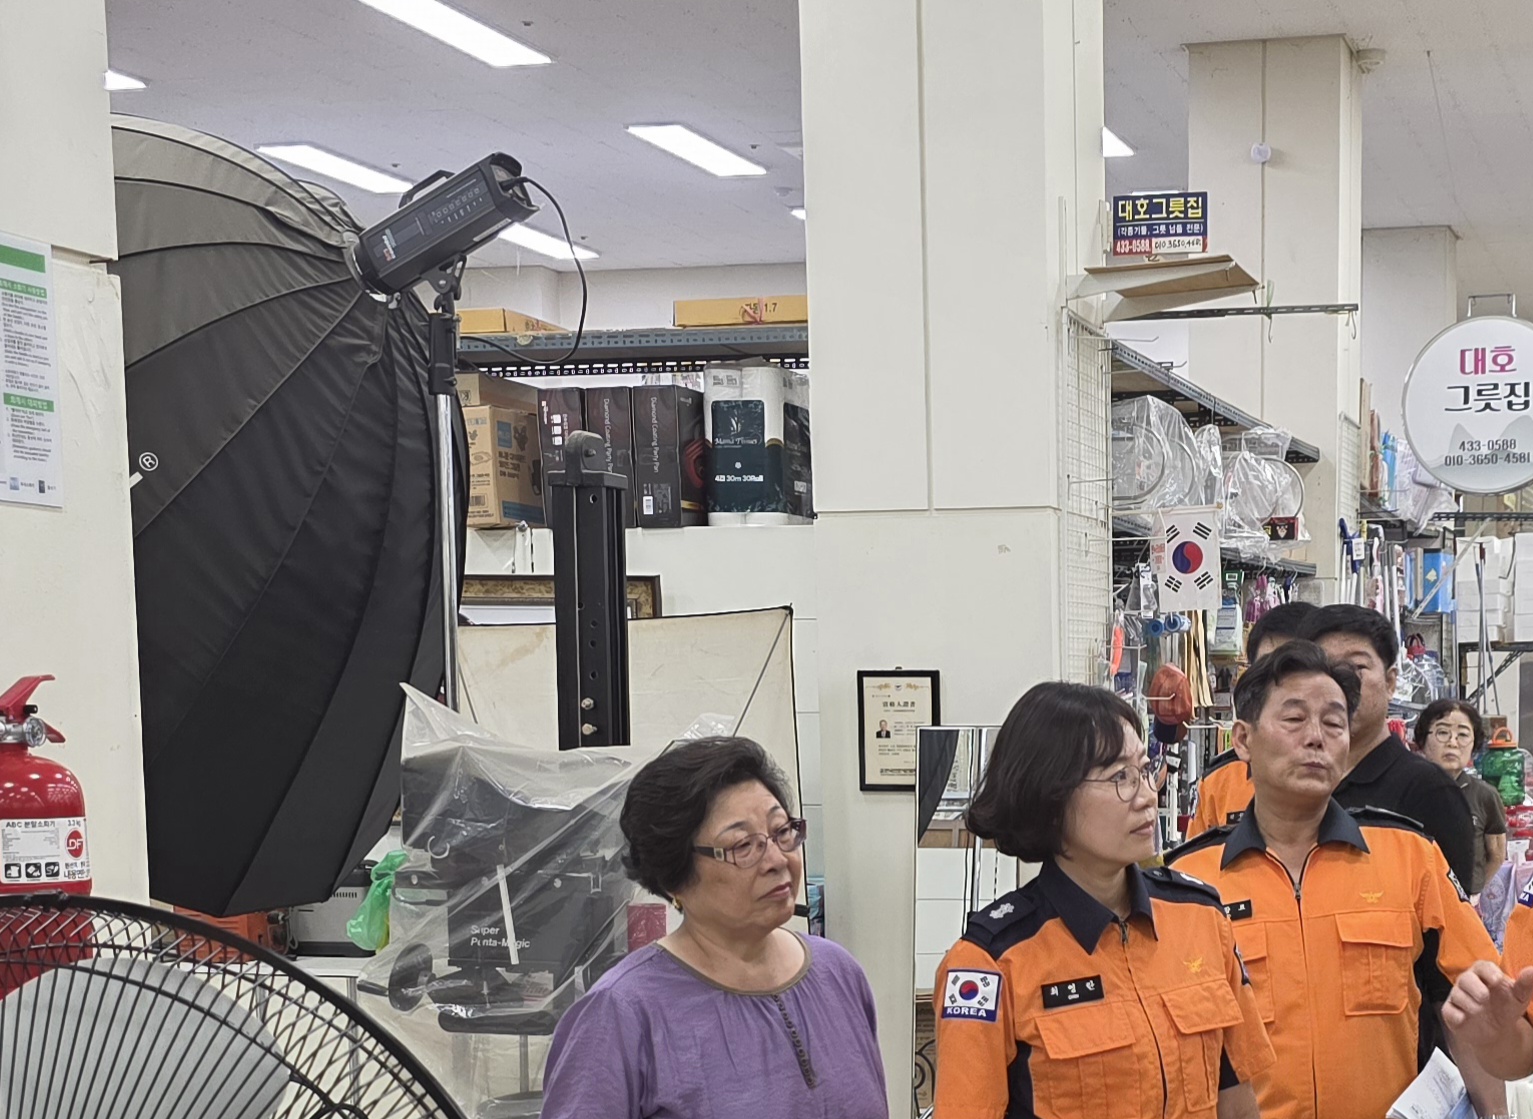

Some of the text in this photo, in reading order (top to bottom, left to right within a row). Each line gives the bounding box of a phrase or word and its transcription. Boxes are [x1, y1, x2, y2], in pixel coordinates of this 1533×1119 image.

[1118, 197, 1203, 221] 대호그릇집
[1459, 345, 1517, 376] 대호
[1444, 382, 1531, 413] 그릇집
[1459, 438, 1517, 452] 433-0588
[1444, 452, 1530, 467] 010-3650-4581
[946, 1006, 987, 1017] KOREA
